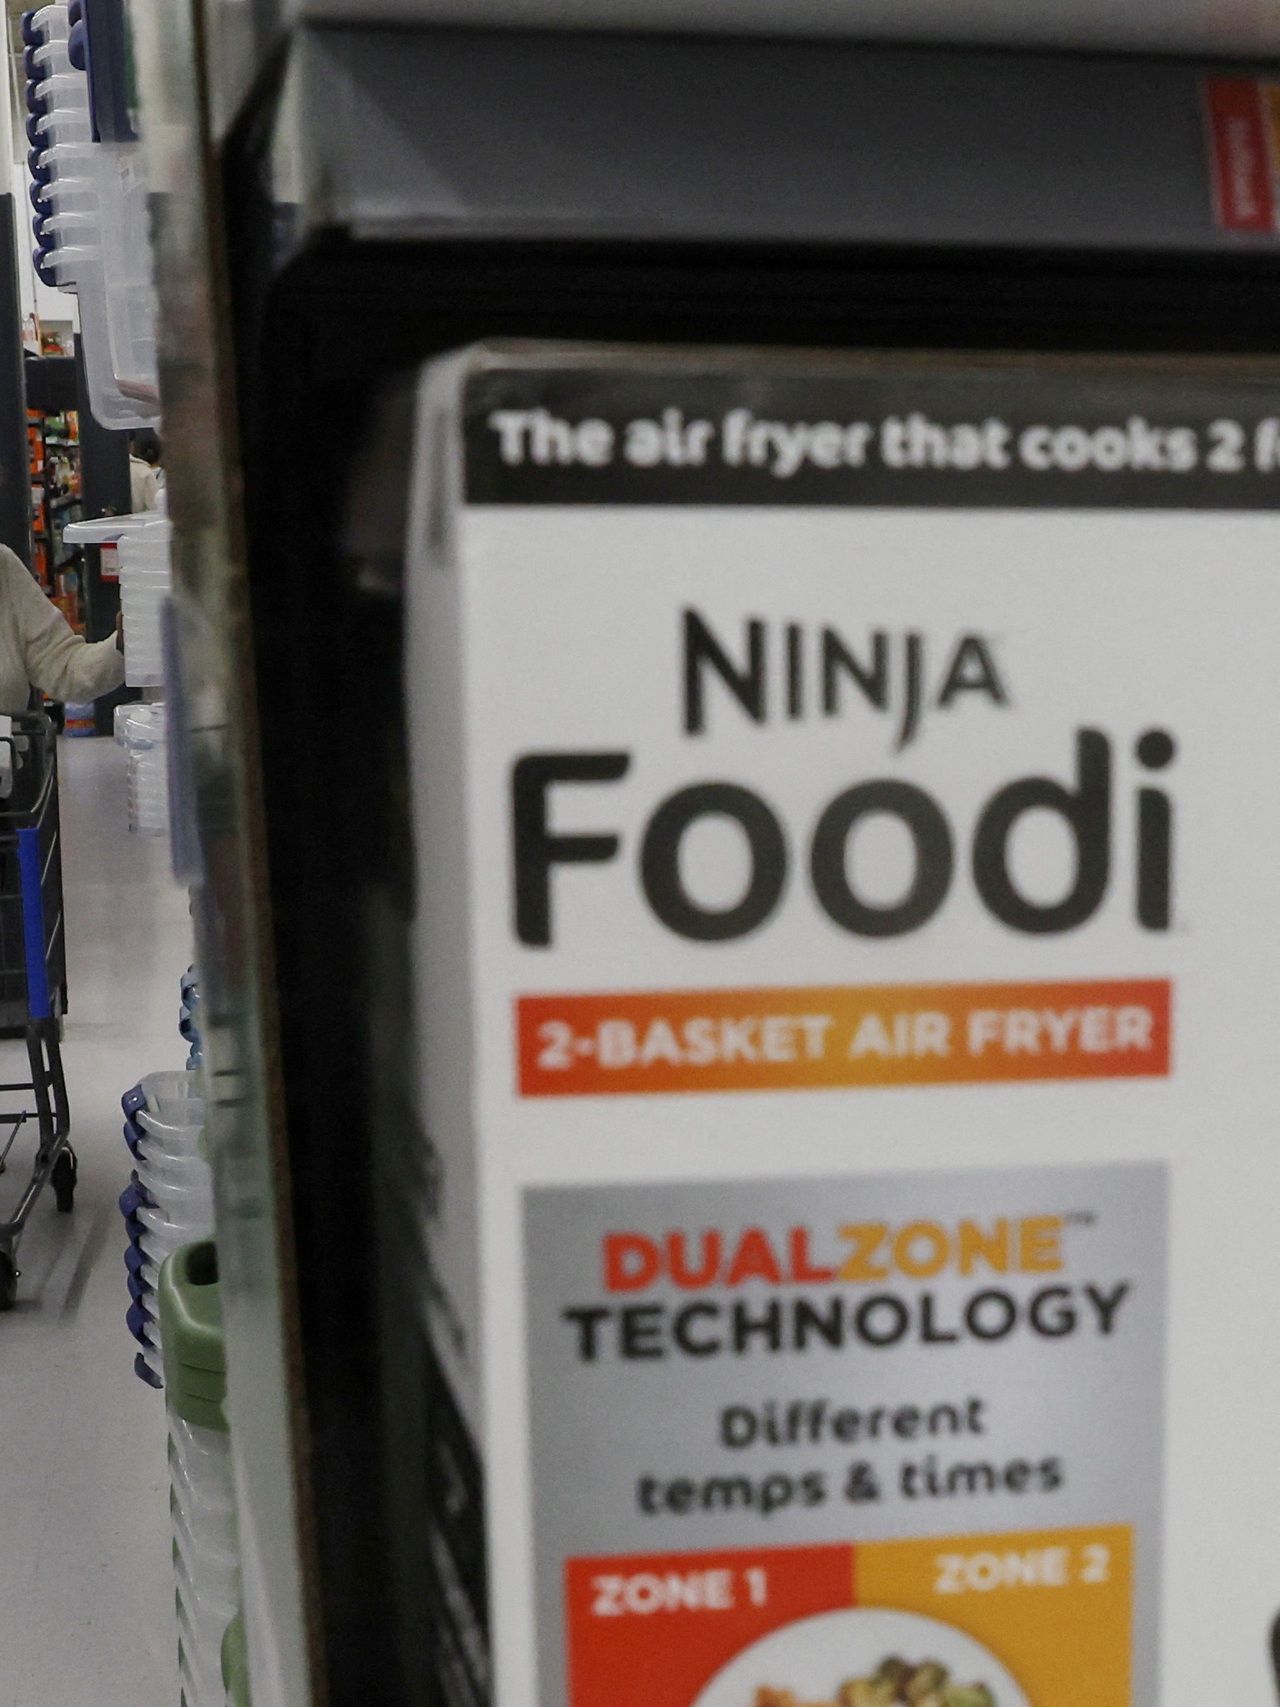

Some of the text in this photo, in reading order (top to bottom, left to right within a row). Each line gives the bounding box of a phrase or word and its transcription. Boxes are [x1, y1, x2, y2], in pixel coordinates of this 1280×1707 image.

[489, 409, 613, 468] The
[624, 408, 715, 468] air
[723, 409, 873, 479] fryer
[881, 414, 1012, 470] that
[1018, 415, 1197, 474] cooks
[1204, 419, 1244, 474] 2
[682, 606, 1010, 756] NINJA
[512, 727, 1177, 949] Foodi
[535, 1004, 1154, 1073] 2-BASKET AIR FRYER
[565, 1281, 1131, 1361] TECHNOLOGY
[719, 1396, 989, 1450] Different
[637, 1455, 1064, 1517] temps & times
[590, 1568, 768, 1616] ZONE 1
[931, 1544, 1111, 1595] ZONE 2
